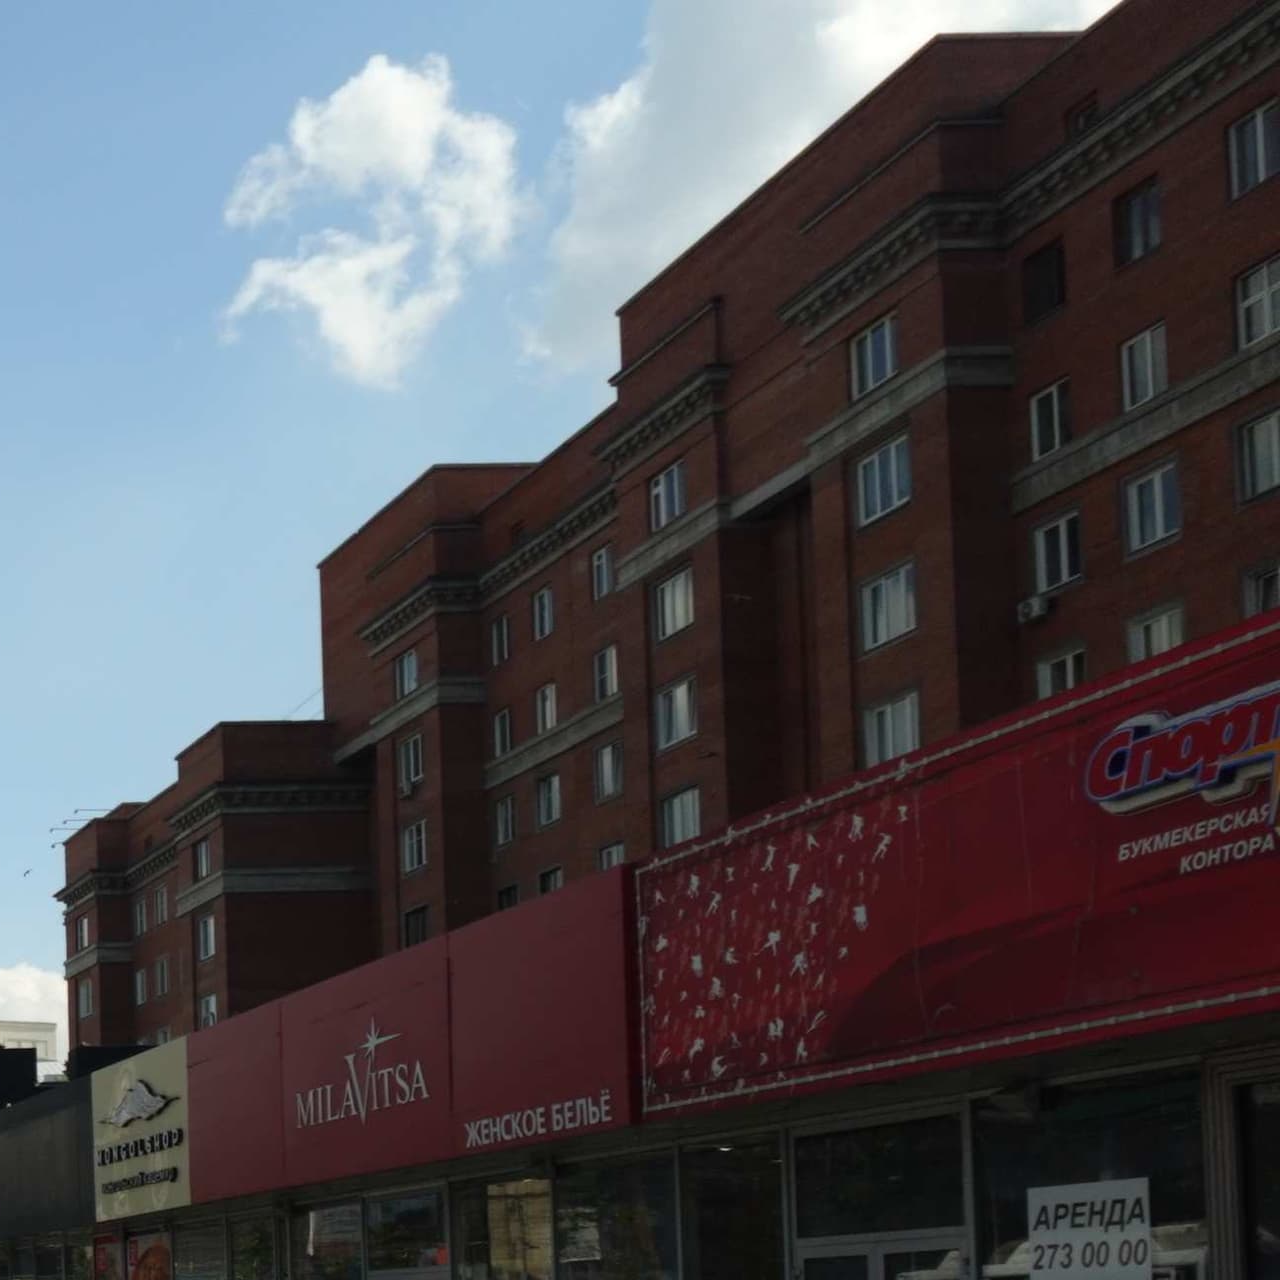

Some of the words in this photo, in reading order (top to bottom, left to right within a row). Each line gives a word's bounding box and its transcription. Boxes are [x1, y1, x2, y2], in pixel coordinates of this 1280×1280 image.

[1118, 803, 1271, 862] БУКМЕКЕРСКАЯ
[1179, 833, 1276, 875] КОНТОРА
[296, 1048, 430, 1129] MILAVITSA
[464, 1106, 547, 1148] ЖЕНСКОЕ
[551, 1089, 613, 1132] БЕЛЬЁ
[1032, 1197, 1145, 1232] АРЕНДА
[1033, 1242, 1072, 1270] 273
[1081, 1241, 1110, 1267] 00
[1119, 1238, 1148, 1265] 00
